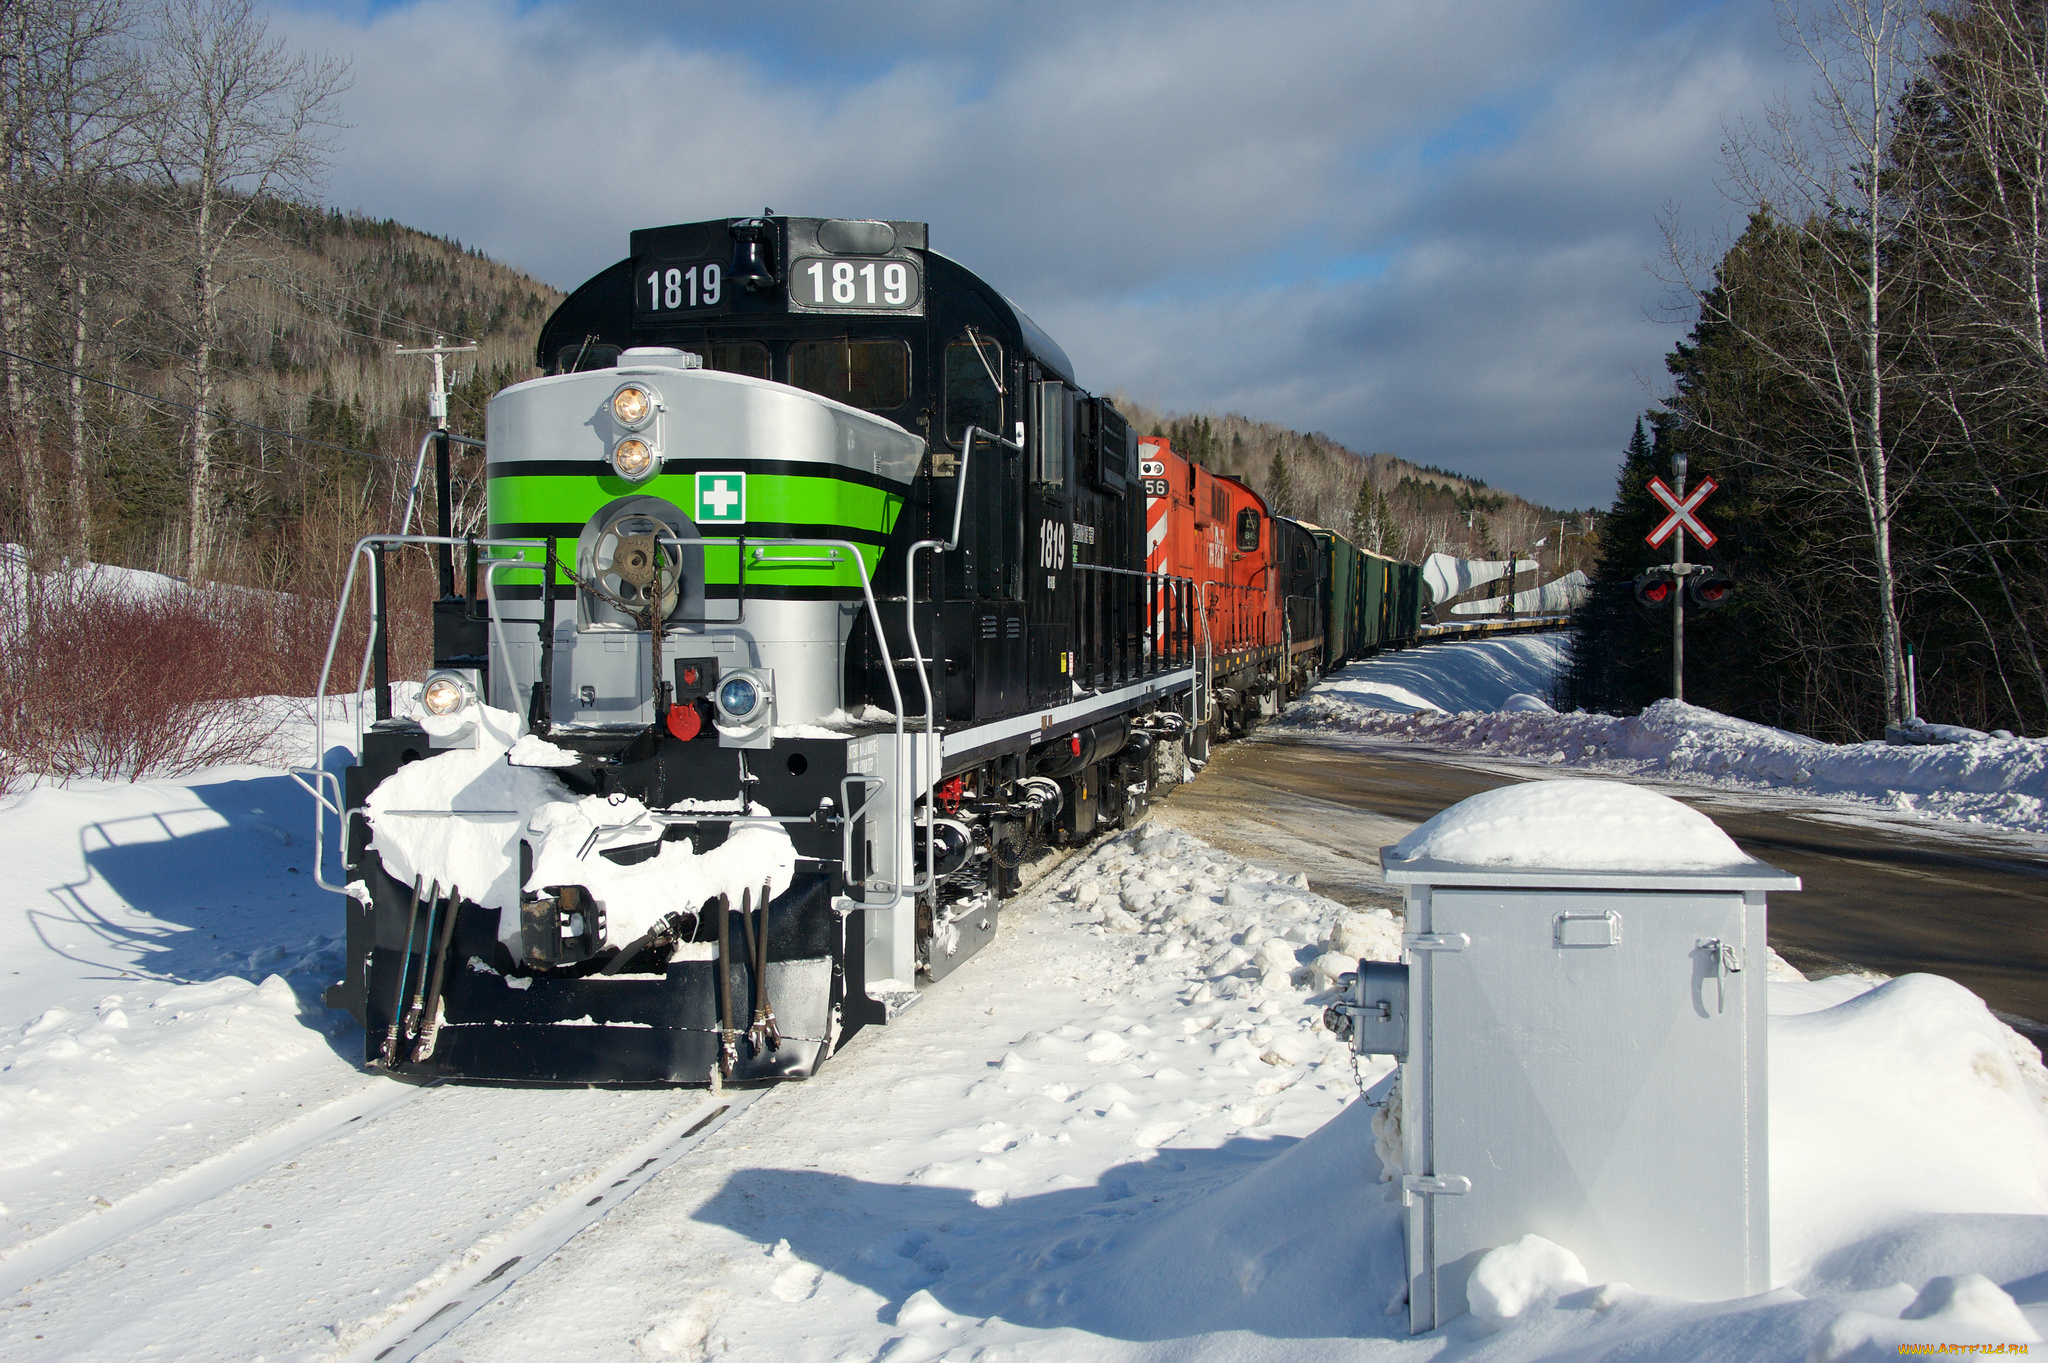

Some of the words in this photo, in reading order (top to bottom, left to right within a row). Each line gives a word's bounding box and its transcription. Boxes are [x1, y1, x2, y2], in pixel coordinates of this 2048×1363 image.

[647, 263, 721, 311] 1819
[807, 262, 908, 305] 1819
[1145, 480, 1165, 495] 56
[1040, 518, 1065, 571] 1819
